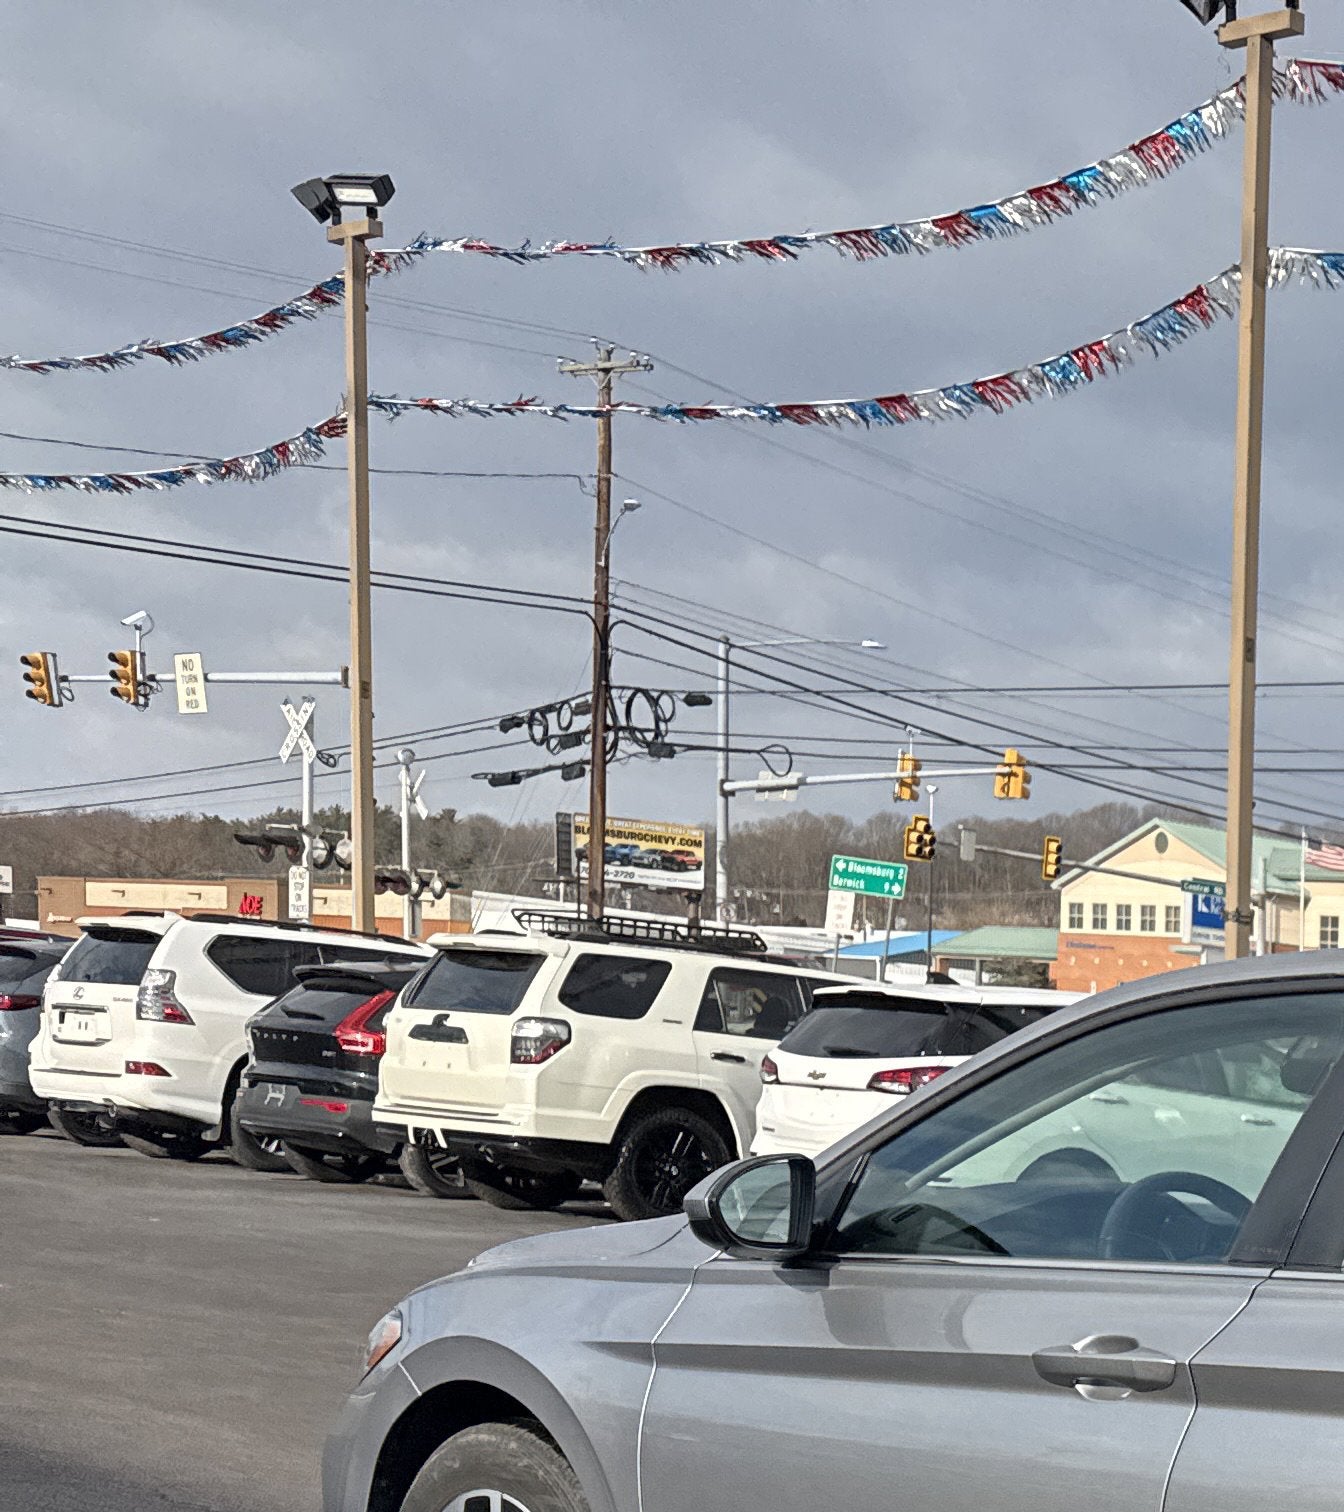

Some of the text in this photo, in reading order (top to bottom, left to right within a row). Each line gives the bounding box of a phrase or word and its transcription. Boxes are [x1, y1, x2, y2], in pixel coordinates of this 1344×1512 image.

[181, 658, 194, 671] NO
[181, 674, 198, 684] TURN
[185, 686, 196, 696] ON
[185, 699, 200, 709] RED
[574, 825, 703, 848] BLOMSBURGCHEVY.COM
[848, 861, 895, 881] Bloomsburg
[832, 874, 865, 890] Berwick
